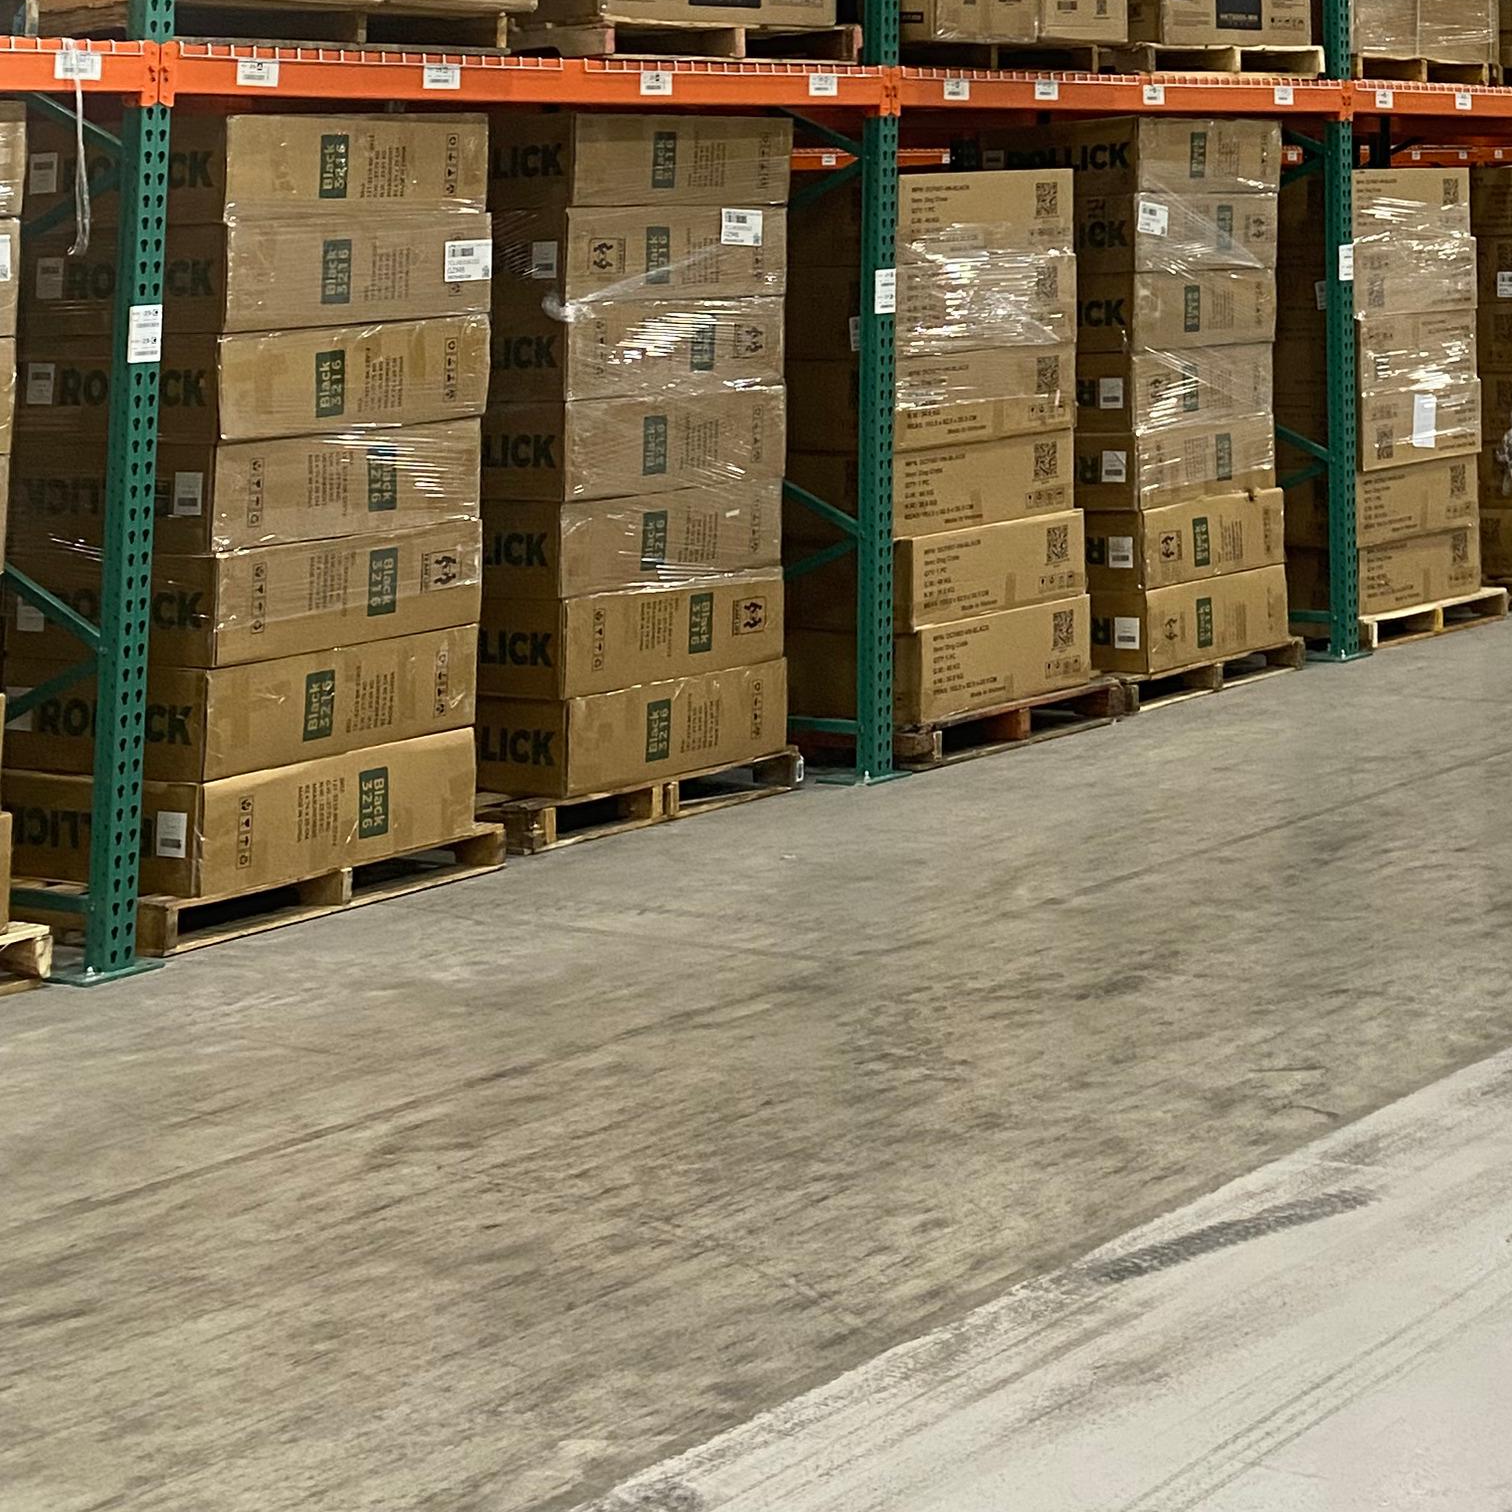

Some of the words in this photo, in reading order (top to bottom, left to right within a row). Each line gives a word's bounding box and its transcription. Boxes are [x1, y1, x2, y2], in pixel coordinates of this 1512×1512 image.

[322, 143, 335, 190] Black
[325, 249, 338, 295] Black
[319, 361, 331, 408] Black
[331, 359, 342, 406] 3216
[370, 559, 382, 608] 3216
[382, 557, 394, 606] Black
[307, 682, 320, 731] Black
[659, 707, 669, 751] 3216
[648, 708, 660, 753] Black
[362, 779, 372, 829] 3216
[373, 777, 385, 826] Black
